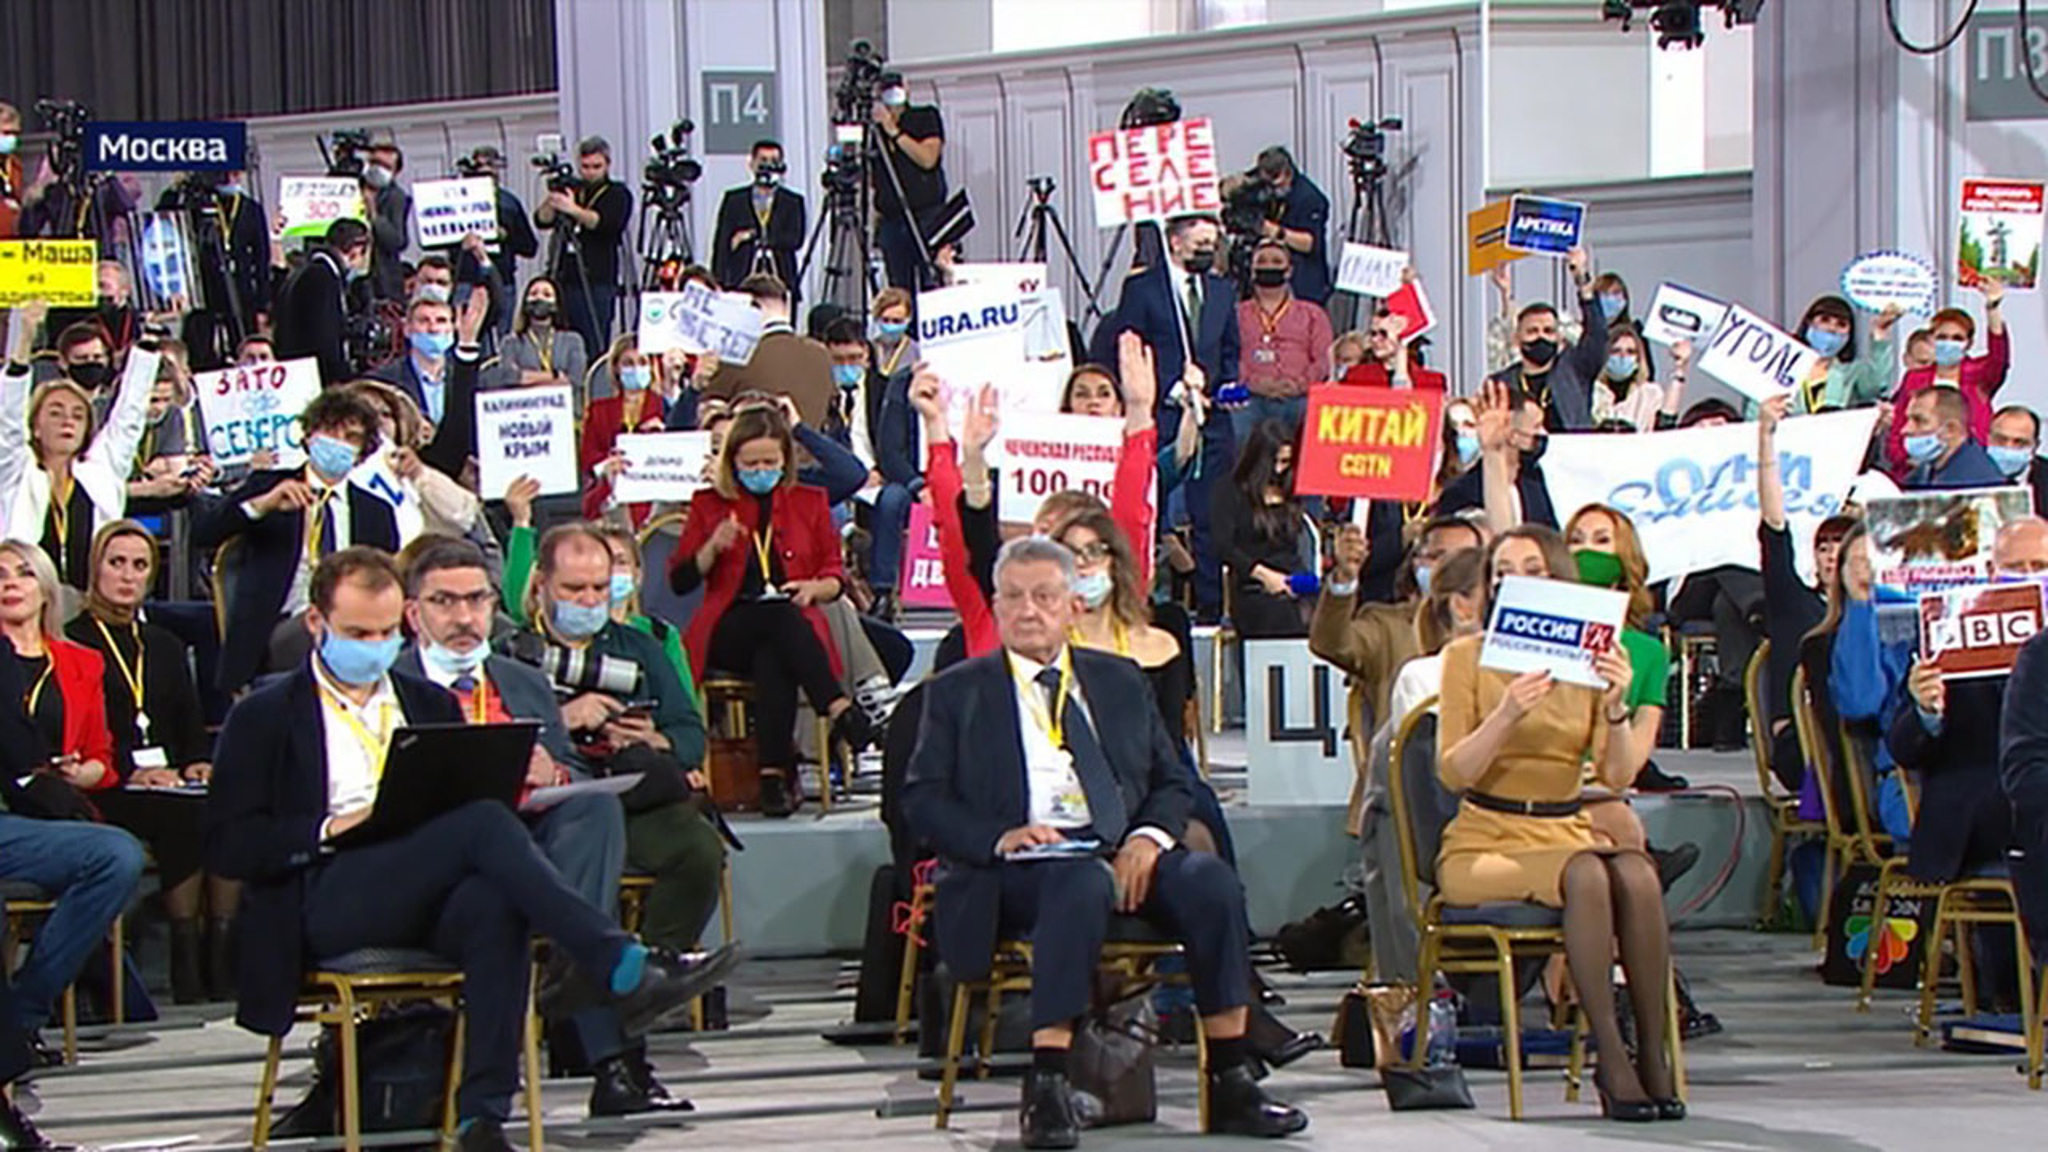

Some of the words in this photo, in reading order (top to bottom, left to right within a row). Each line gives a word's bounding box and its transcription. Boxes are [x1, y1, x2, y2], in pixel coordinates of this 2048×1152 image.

[1977, 27, 2048, 79] П3
[710, 83, 769, 124] П4
[1088, 117, 1211, 162] ПЕРЕ
[1095, 153, 1213, 192] СЕЛЕ
[1123, 182, 1220, 221] НИЕ
[22, 241, 94, 264] Маша
[921, 303, 1019, 340] URA.RU
[1712, 311, 1802, 388] УГОЛЬ
[215, 365, 287, 395] ЗАТО
[499, 415, 552, 438] НОВЫЙ
[1317, 402, 1429, 447] КИТАЙ
[504, 440, 550, 458] КРЫМ
[1011, 468, 1068, 495] 100
[910, 558, 945, 587] ДВ
[1501, 611, 1580, 641] РОССИЯ
[1268, 665, 1350, 758] Ц
